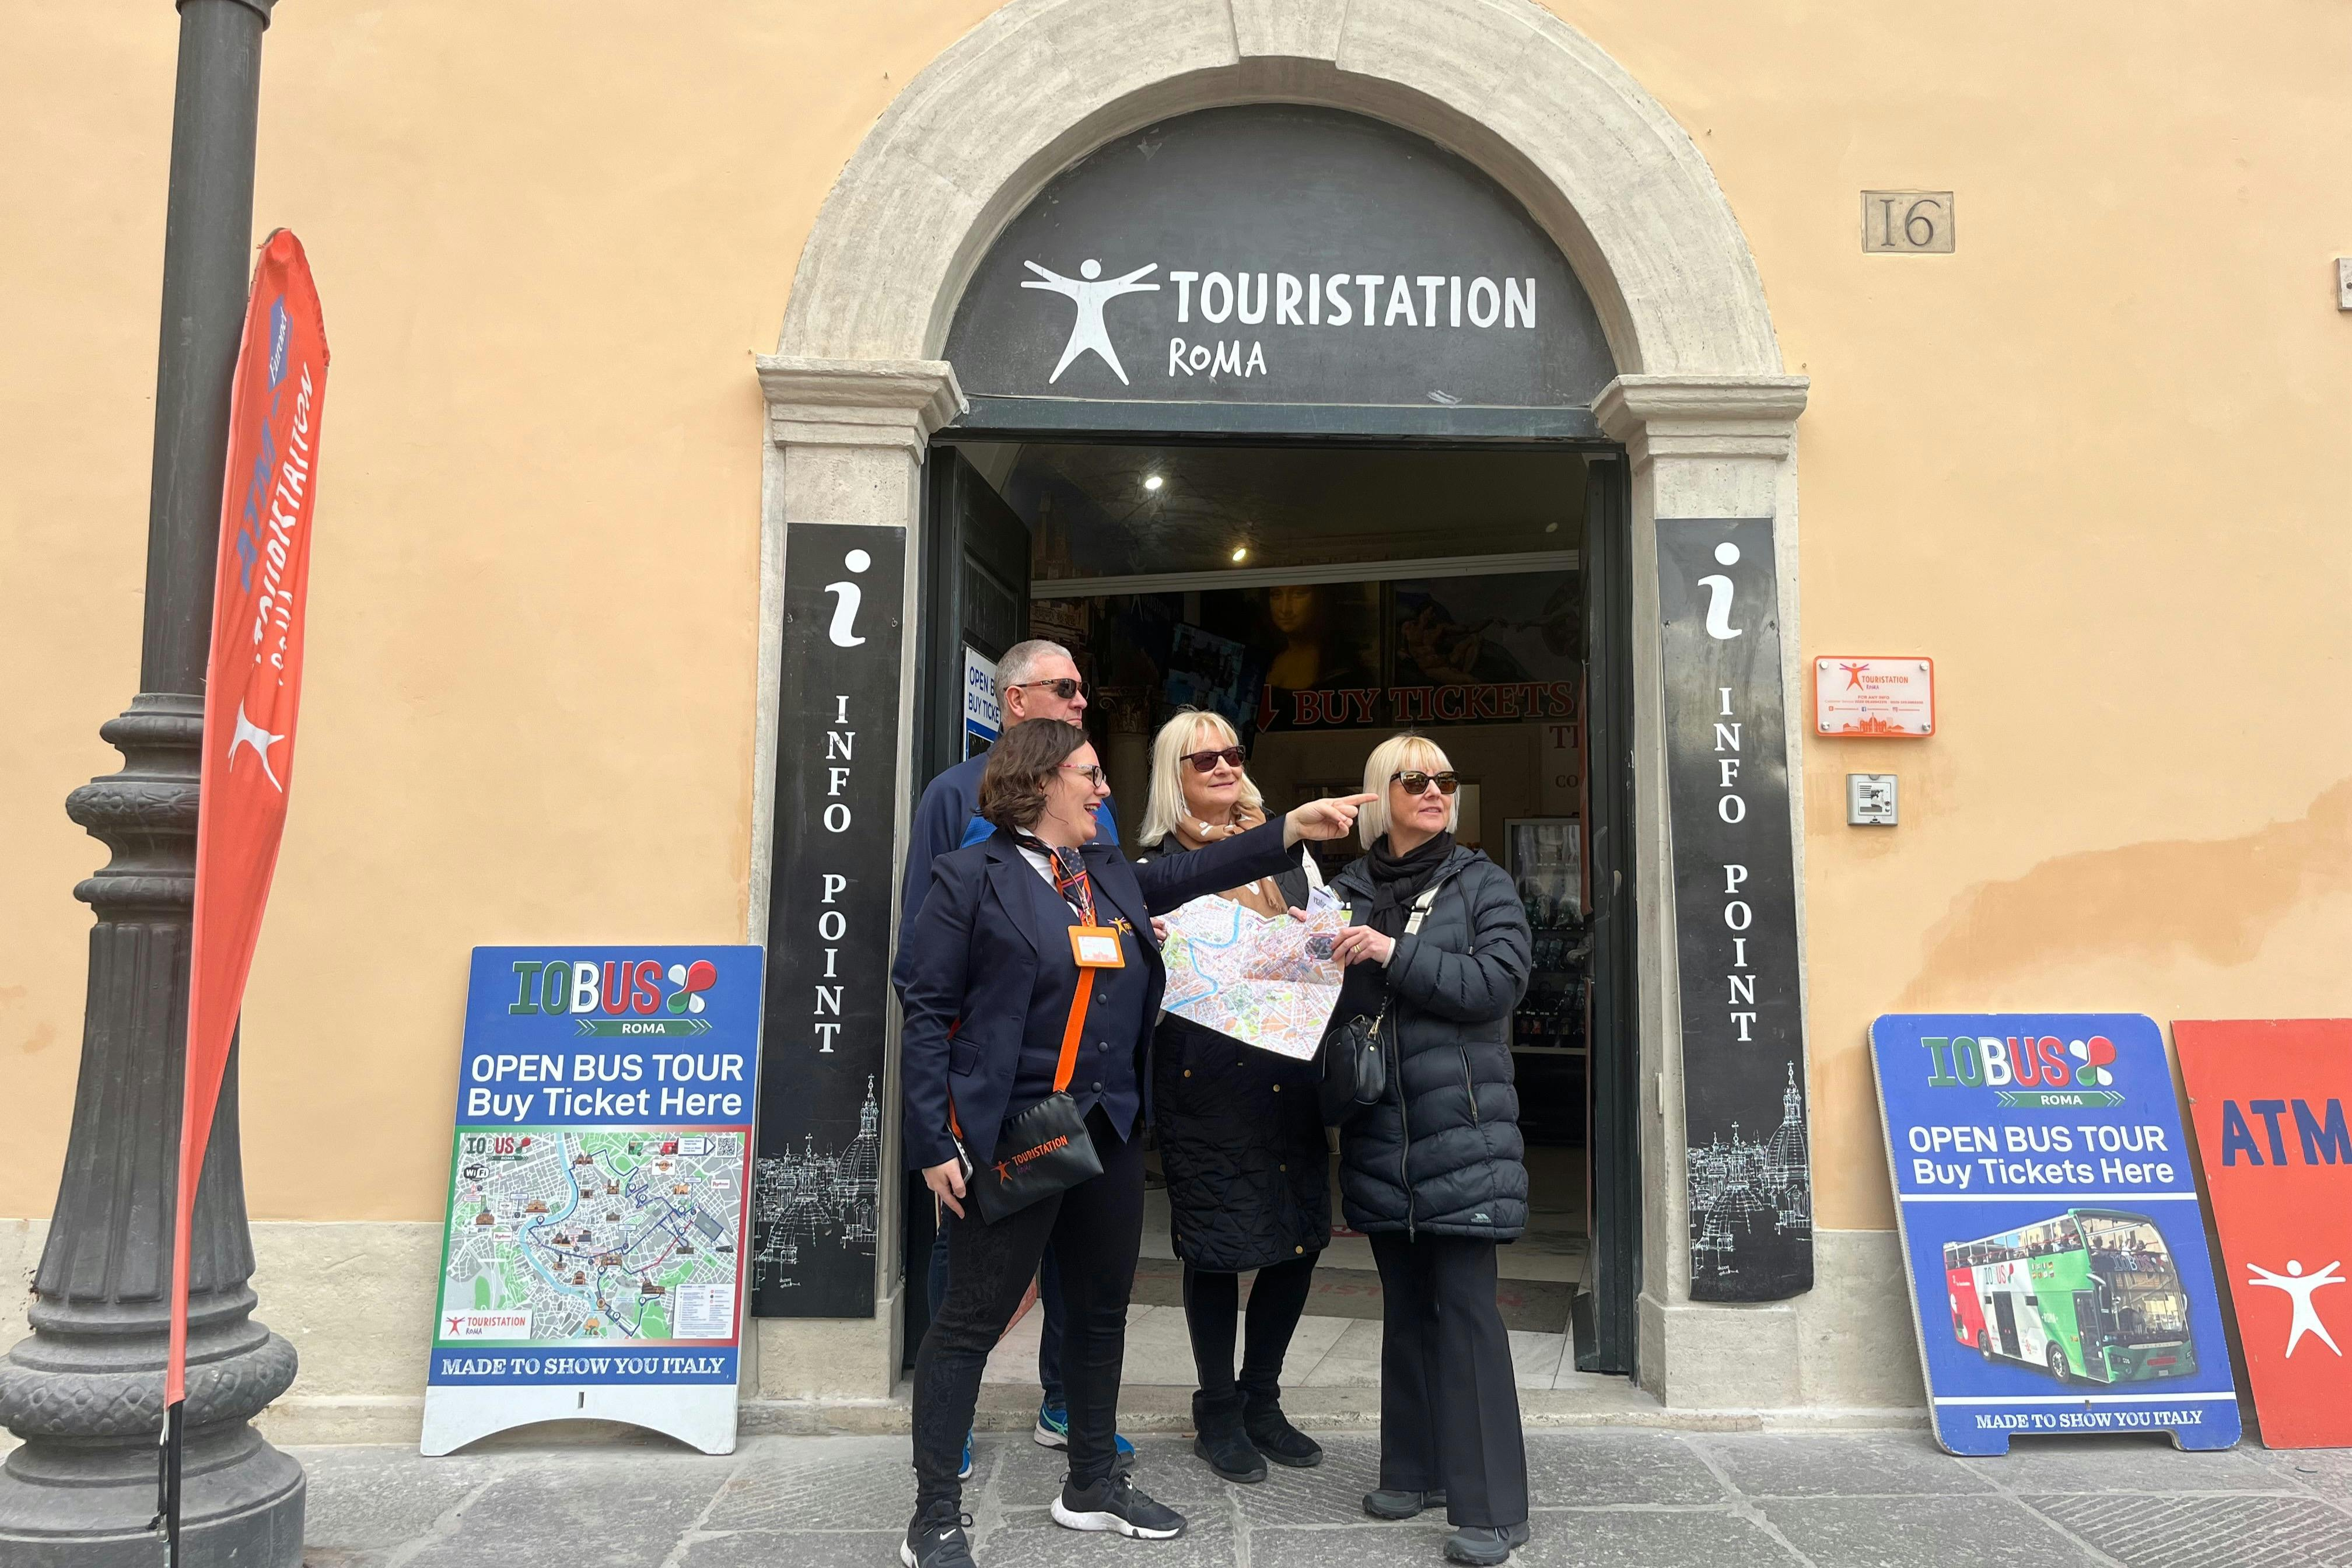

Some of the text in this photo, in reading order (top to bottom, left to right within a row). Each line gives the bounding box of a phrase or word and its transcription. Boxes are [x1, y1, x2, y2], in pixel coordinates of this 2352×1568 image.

[1879, 199, 1941, 246] 16
[1169, 271, 1536, 328] TOURISTATION
[1168, 337, 1267, 377] ROMA
[969, 666, 988, 693] OPEN
[968, 692, 1000, 724] BUY TICKE
[1293, 681, 1574, 725] BUY TICKETS
[814, 695, 853, 1054] INFO POINT
[1714, 687, 1756, 1042] INFO POINT
[509, 960, 663, 1015] IOBUS
[622, 1023, 666, 1034] ROMA
[471, 1054, 744, 1082] OPEN BUS TOUR
[1921, 1035, 2070, 1087] IOBUS
[467, 1087, 743, 1122] Buy Ticket Here
[2041, 1095, 2083, 1105] ROMA
[467, 1137, 514, 1154] IOBUS
[1908, 1126, 2168, 1153] OPEN BUS TOUR
[2221, 1098, 2352, 1167] ATM
[1012, 1135, 1069, 1166] TOURISTATION
[1913, 1158, 2174, 1189] Buy Tickets Here
[1984, 1265, 2007, 1284] IOUS
[468, 1317, 526, 1326] TOURISTATION
[442, 1357, 725, 1376] MADE TO SHOW YOU ITALY
[1975, 1410, 2203, 1429] MADE TO SHOW YOU ITALY
